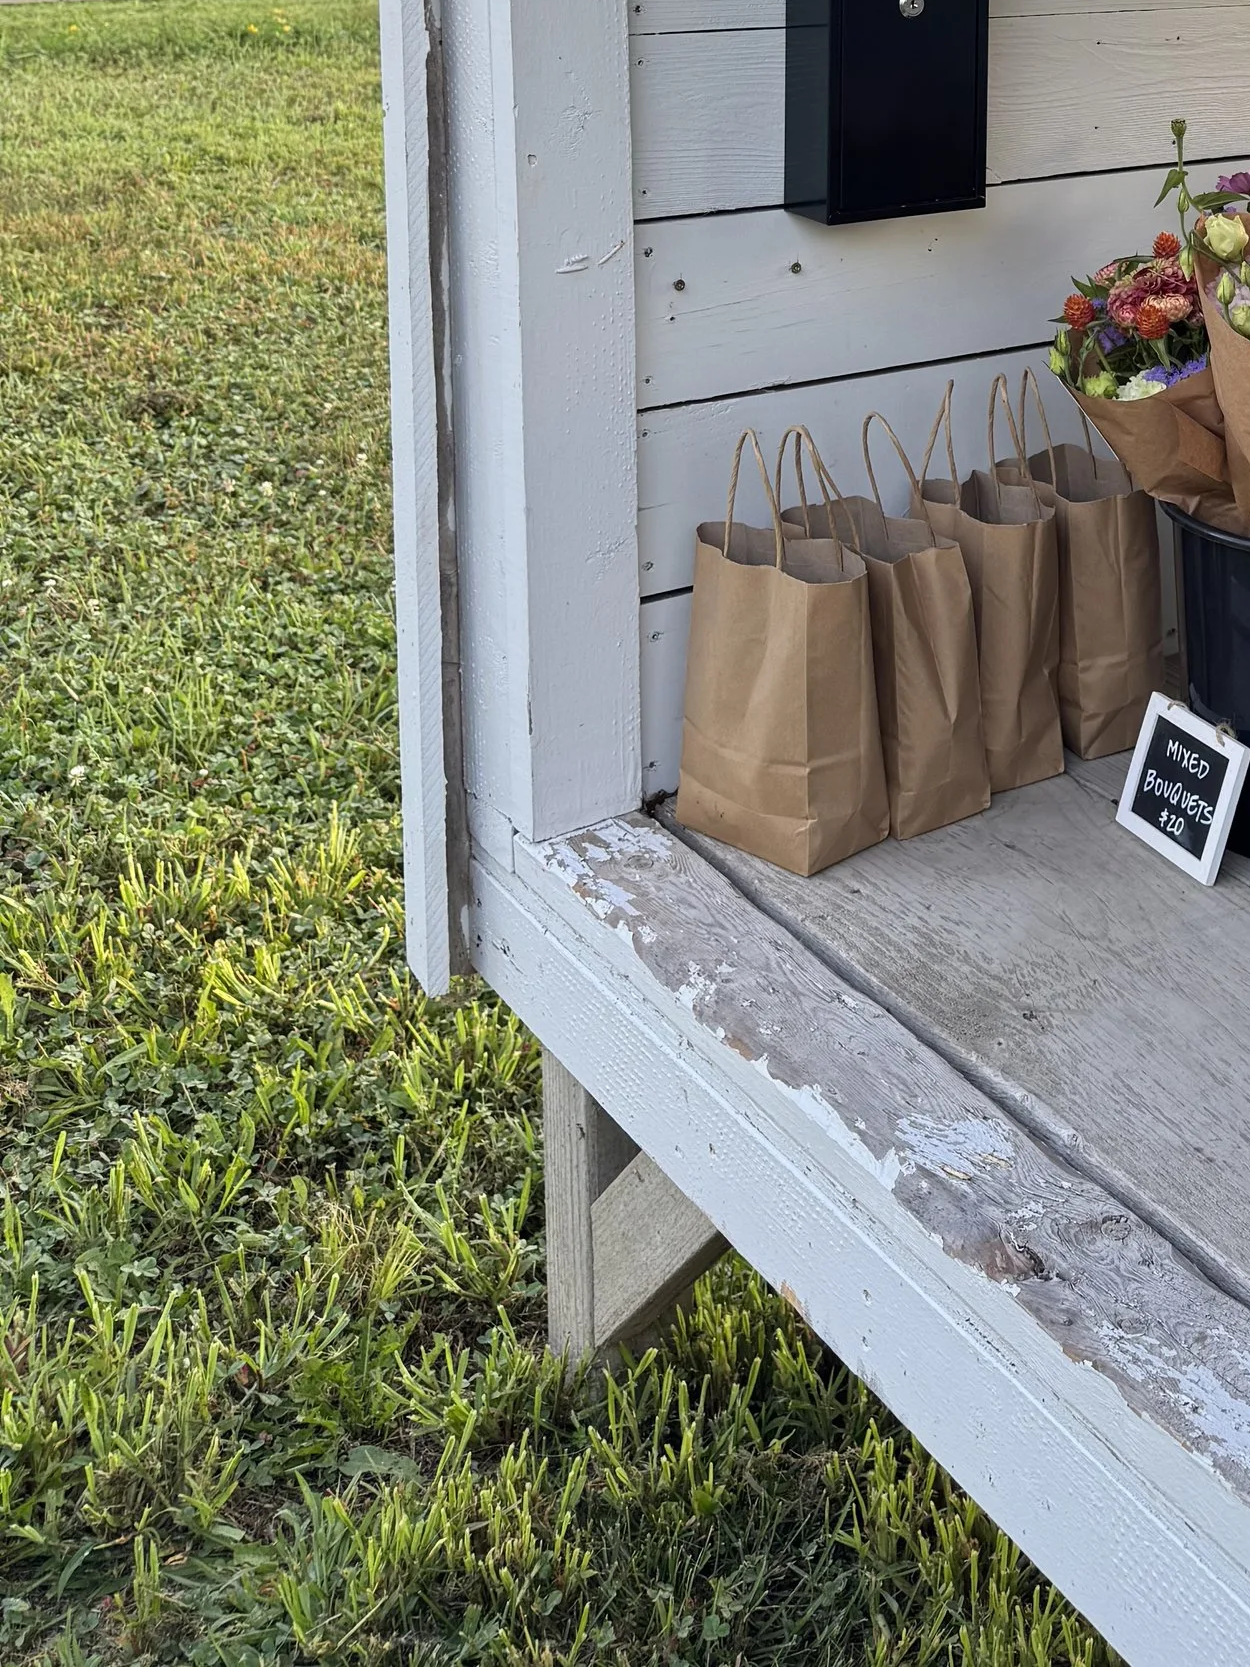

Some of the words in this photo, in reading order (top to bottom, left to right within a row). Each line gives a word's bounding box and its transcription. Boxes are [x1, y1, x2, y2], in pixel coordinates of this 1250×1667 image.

[1166, 739, 1210, 780] MIXED
[1143, 769, 1215, 826] BOUQUETS
[1158, 808, 1185, 836] $20
